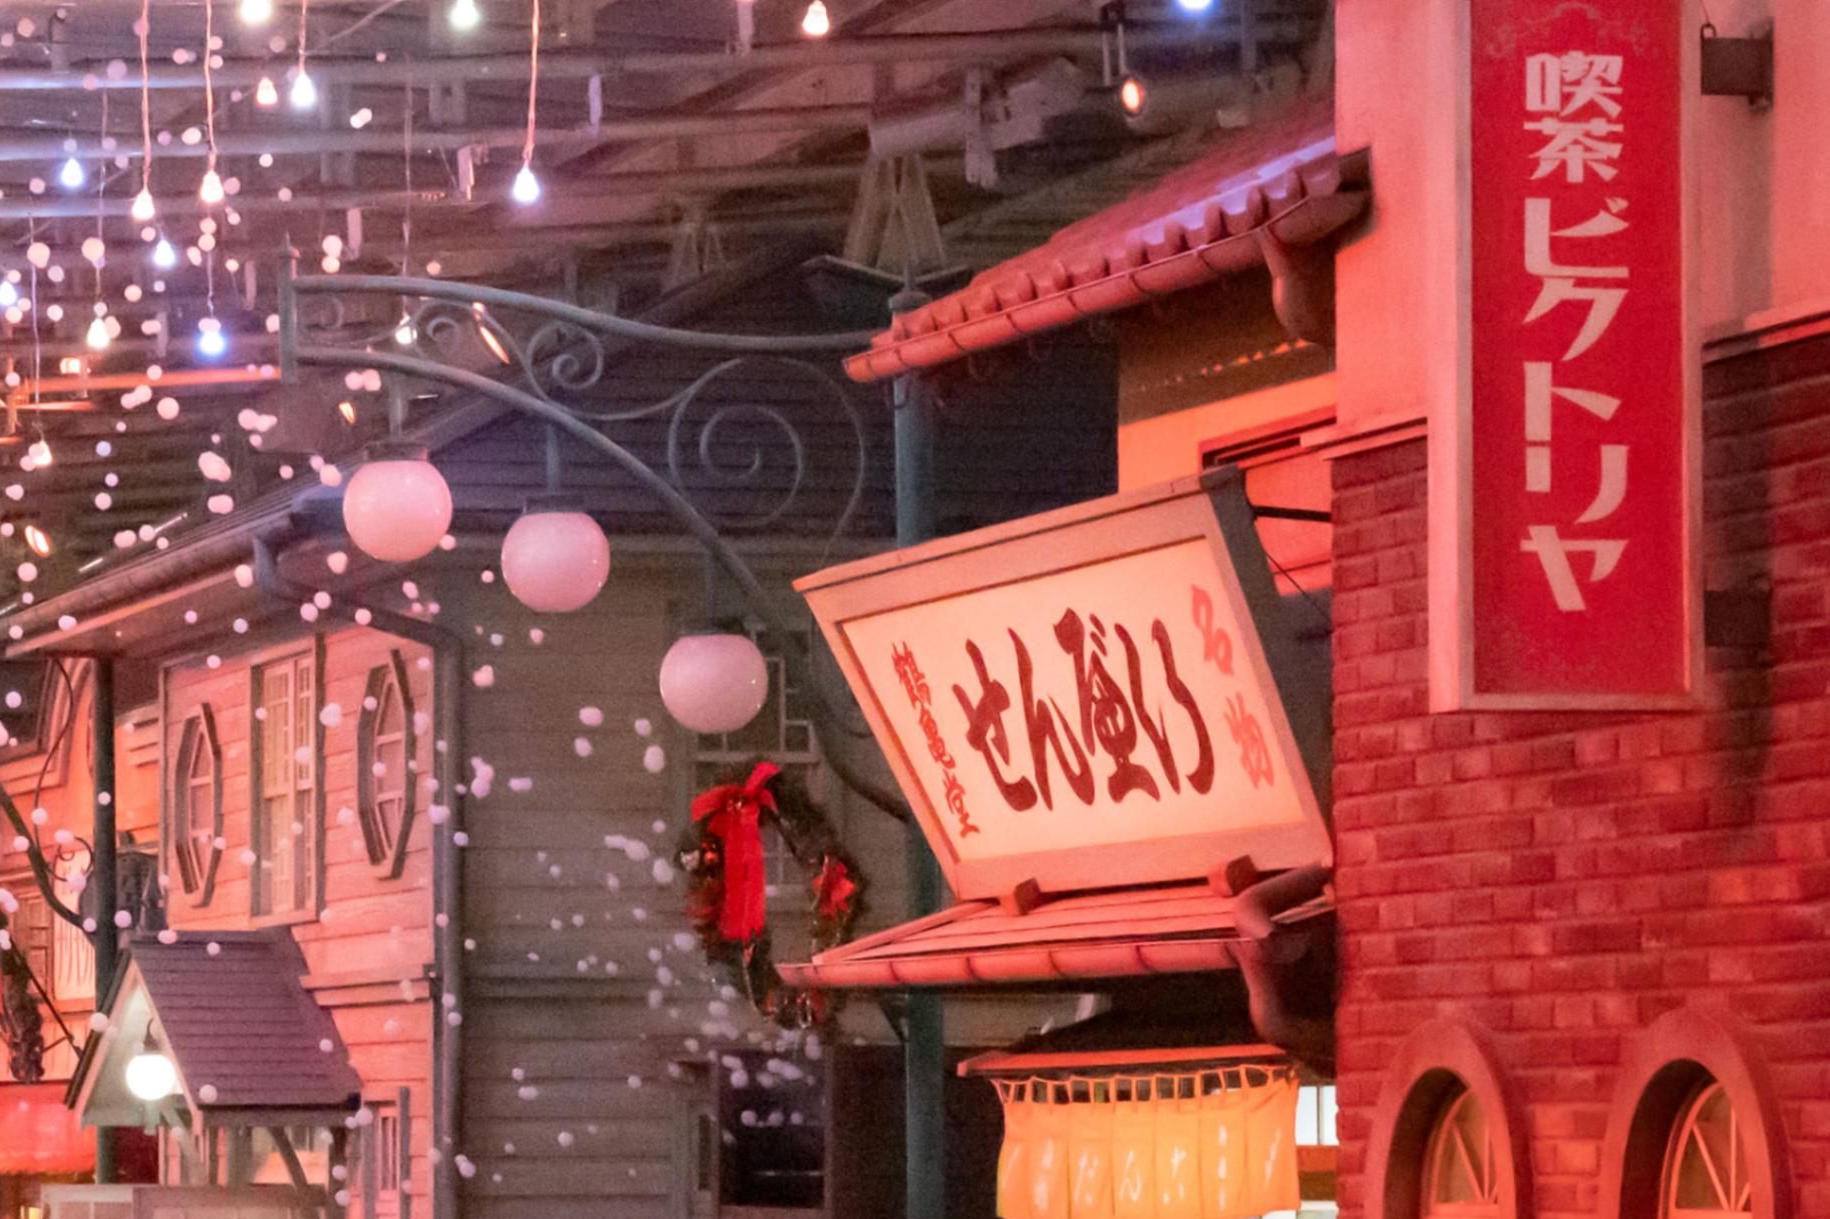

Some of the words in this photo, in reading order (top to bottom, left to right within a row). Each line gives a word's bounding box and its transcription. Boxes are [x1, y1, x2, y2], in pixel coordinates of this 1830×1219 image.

[1521, 50, 1630, 611] 喫茶ビクトリヤ
